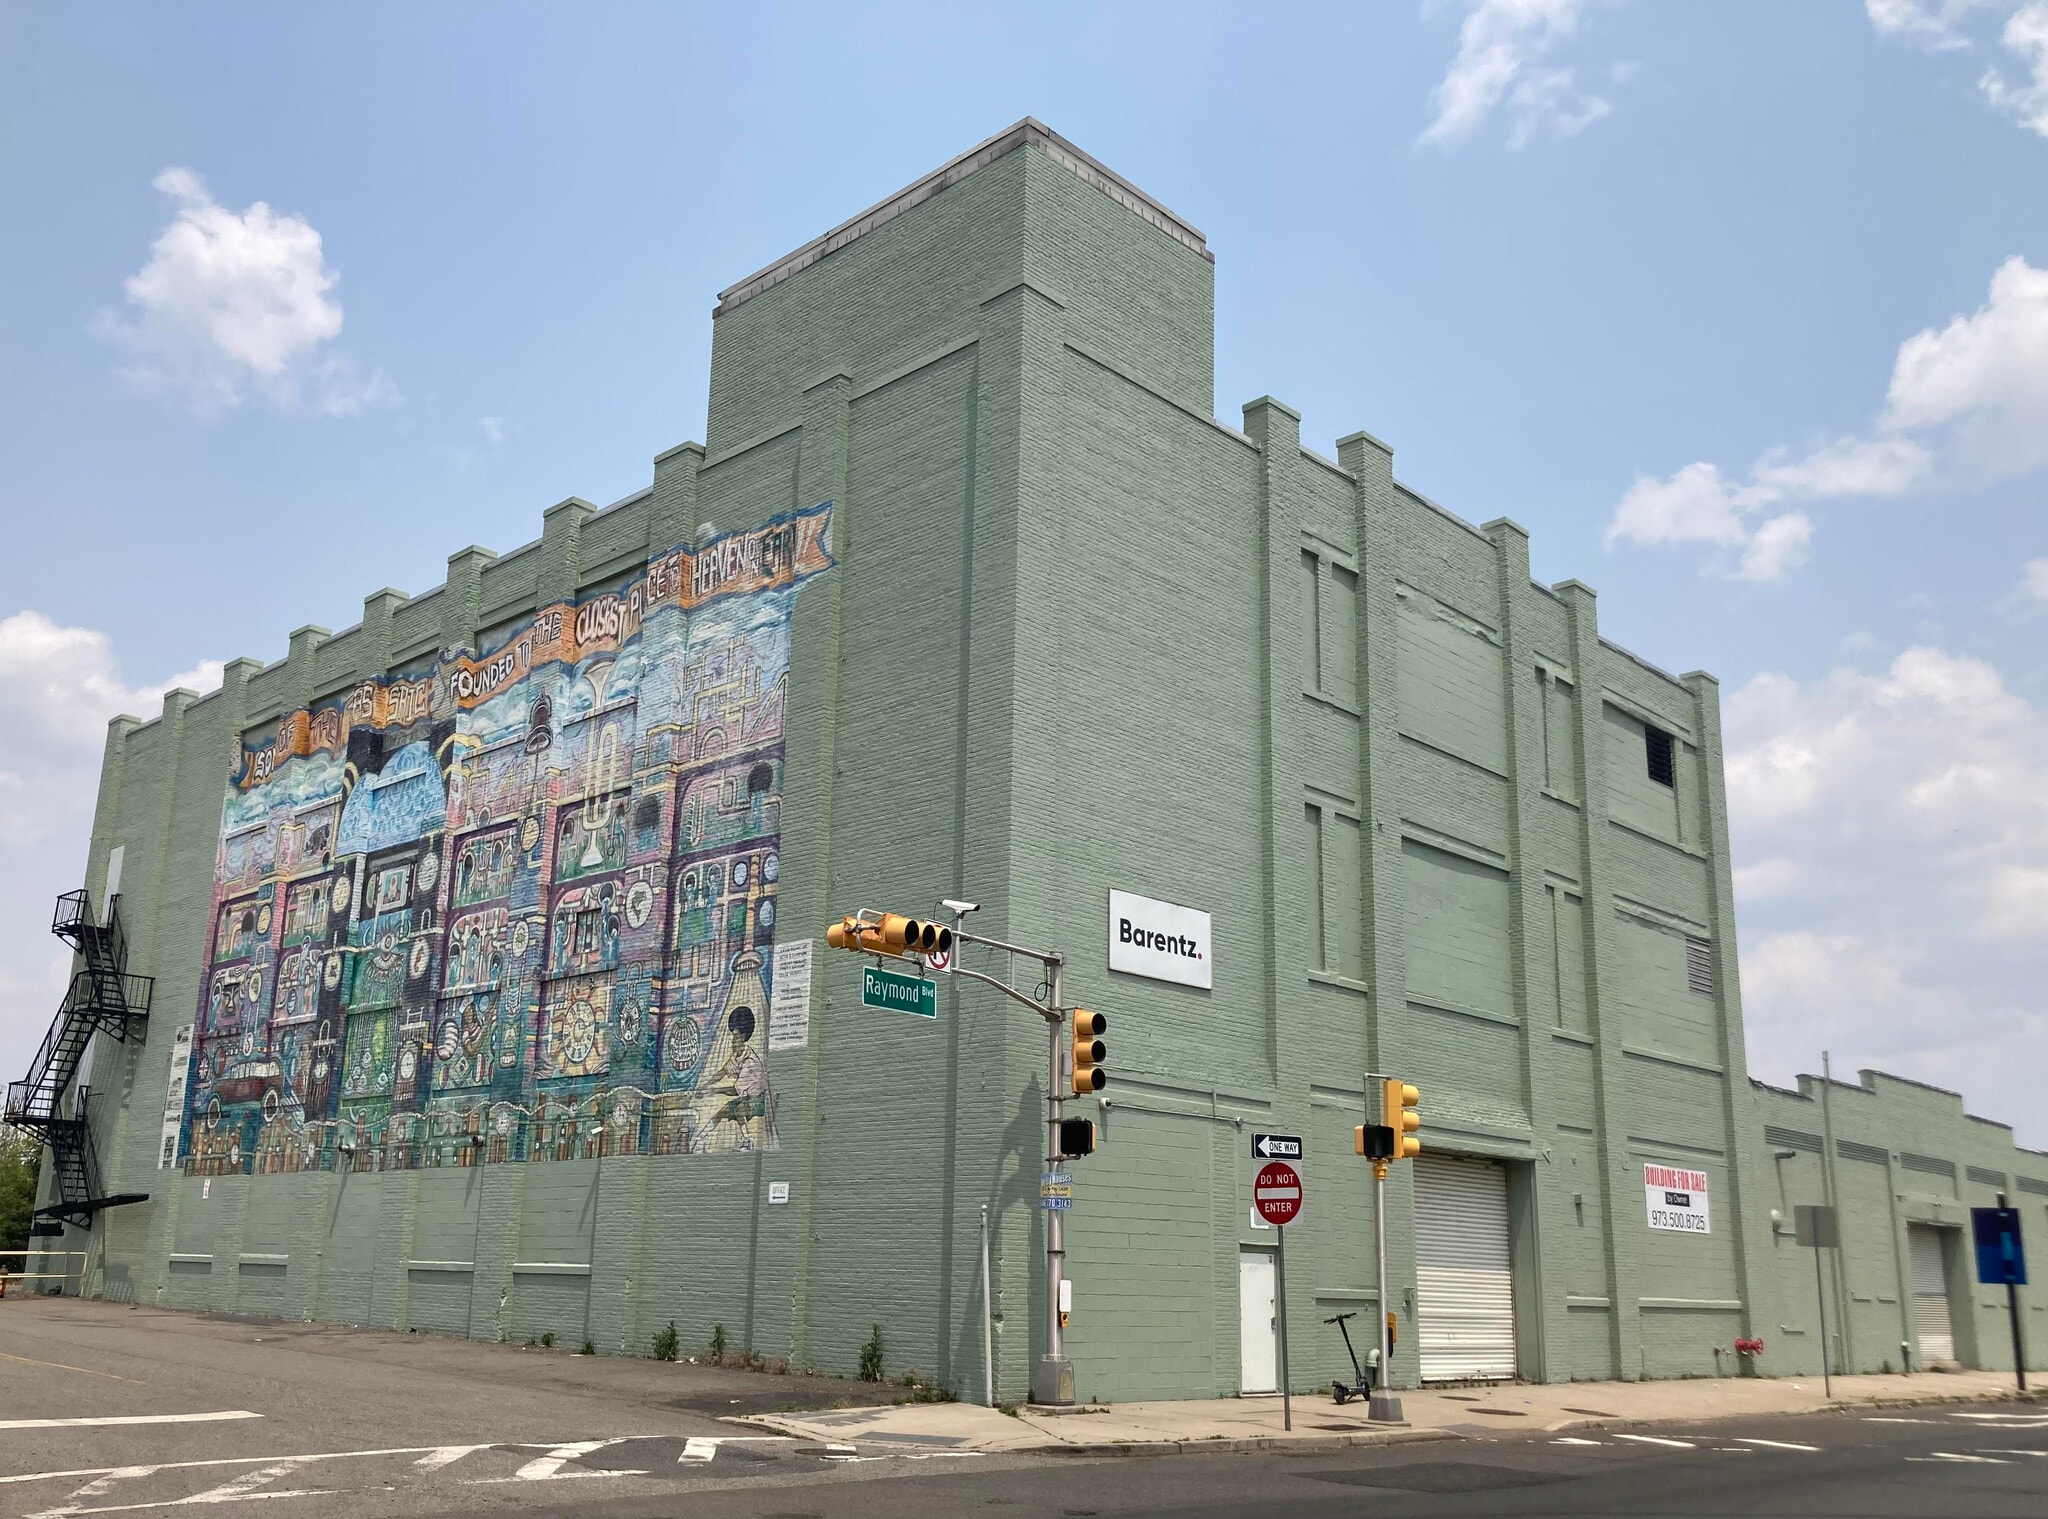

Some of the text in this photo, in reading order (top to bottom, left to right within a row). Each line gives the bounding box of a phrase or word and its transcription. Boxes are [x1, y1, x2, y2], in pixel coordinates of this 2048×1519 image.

[310, 708, 339, 745] THE
[450, 653, 515, 699] FOUNDED
[532, 611, 563, 645] THE
[576, 594, 627, 646] CLOSEST
[692, 533, 750, 598] HEAVEN
[1120, 918, 1202, 960] Barentz.
[866, 975, 934, 1002] Raymond Blvd
[1269, 1142, 1298, 1152] ONE WAY
[1260, 1174, 1294, 1185] DO NOT
[1645, 1165, 1706, 1192] BUILDING FOR SALE
[1264, 1202, 1292, 1213] ENTER
[1652, 1210, 1705, 1230] 973.500.8725
